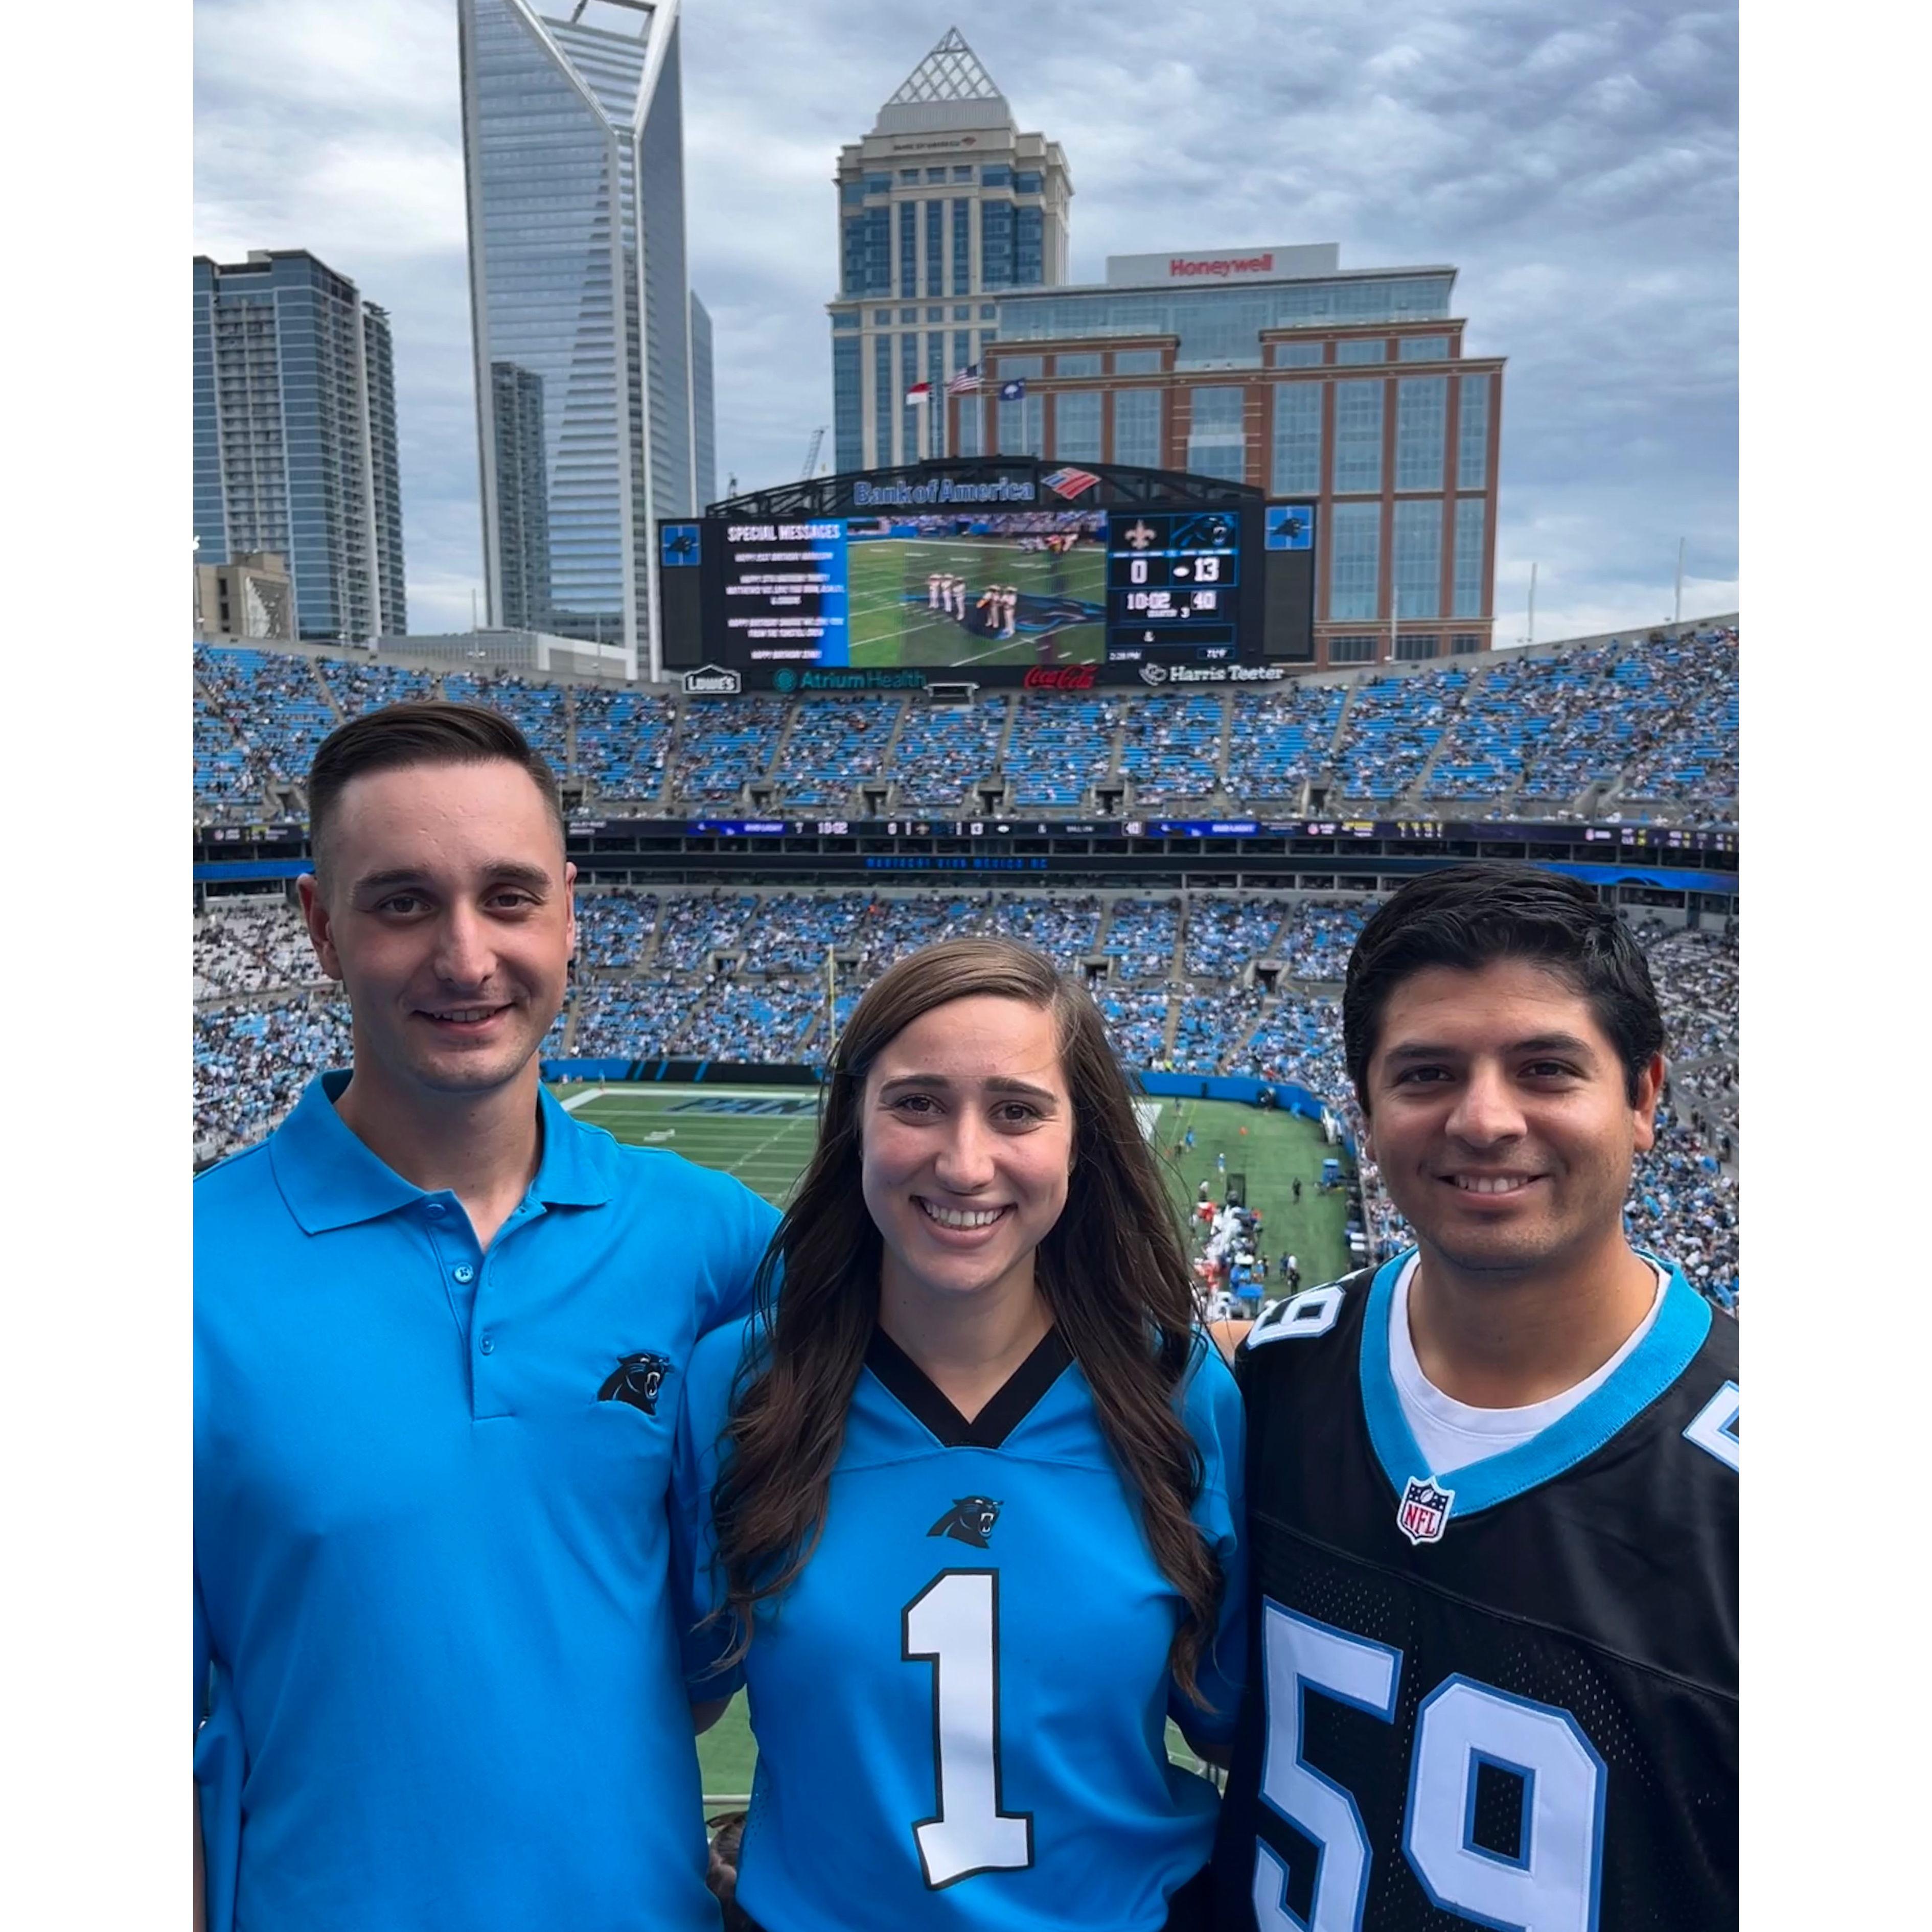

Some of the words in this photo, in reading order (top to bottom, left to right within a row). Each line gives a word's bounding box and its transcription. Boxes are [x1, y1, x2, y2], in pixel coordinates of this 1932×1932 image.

[1169, 254, 1273, 277] Honeywell
[853, 480, 913, 505] Bank
[912, 479, 939, 503] of
[939, 477, 1035, 502] America
[727, 525, 777, 542] SPECIAL
[778, 524, 841, 541] MESSAGES
[1131, 559, 1148, 584] 0
[1194, 557, 1220, 582] 13
[1127, 591, 1170, 610] 10:02
[1192, 591, 1216, 609] 40
[1180, 607, 1190, 618] 3
[688, 675, 735, 691] LOWE'S
[800, 671, 865, 688] Atrium
[866, 669, 926, 688] Health
[1169, 665, 1226, 682] Harris
[1228, 665, 1284, 681] Teeter
[1405, 1503, 1437, 1535] NFL
[901, 1567, 1033, 1891] 1
[1252, 1594, 1608, 1932] 59
